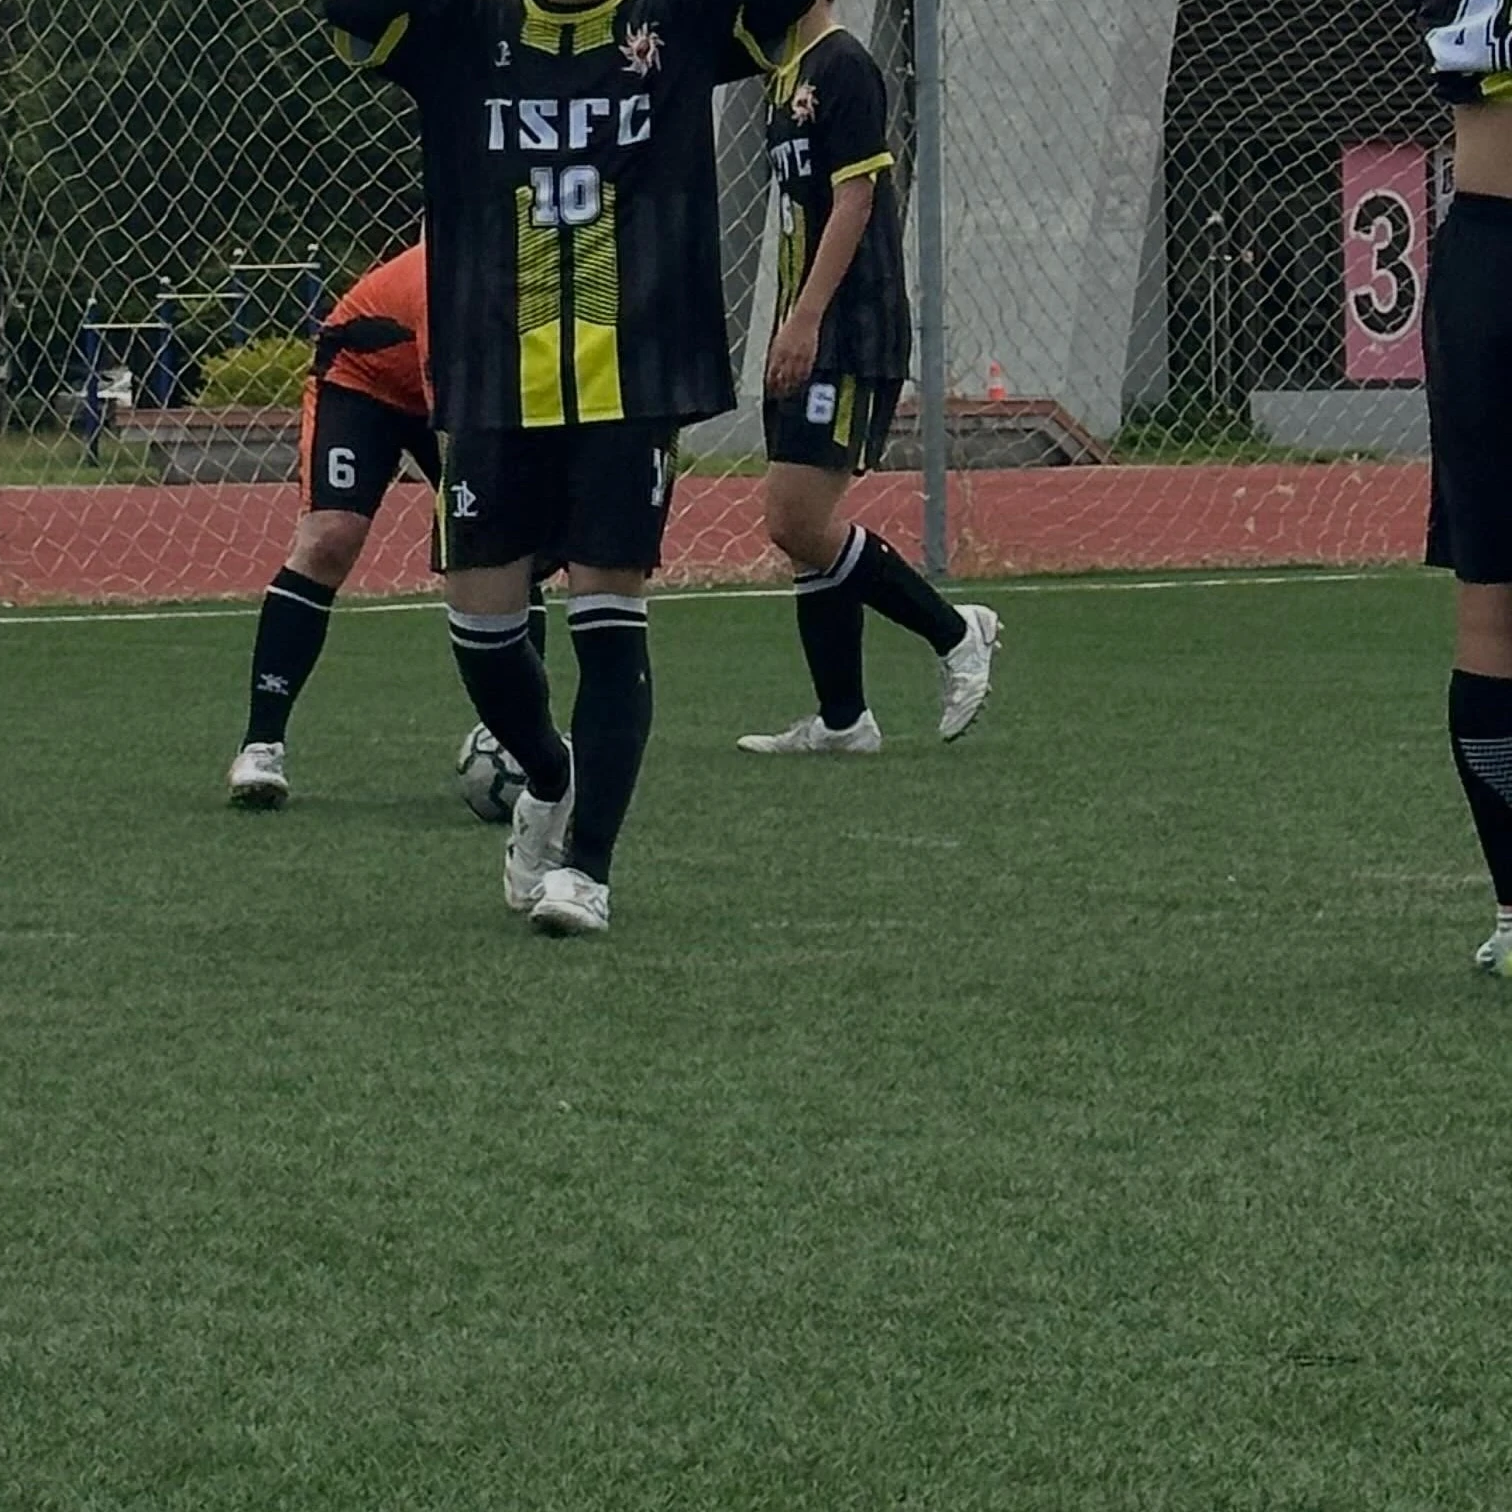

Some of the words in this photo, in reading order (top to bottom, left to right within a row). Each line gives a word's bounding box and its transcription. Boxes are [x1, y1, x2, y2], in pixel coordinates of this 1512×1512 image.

[484, 93, 652, 151] TSFC
[530, 164, 601, 227] 10
[1349, 189, 1420, 341] 3
[806, 382, 836, 424] 6
[328, 447, 355, 488] 6
